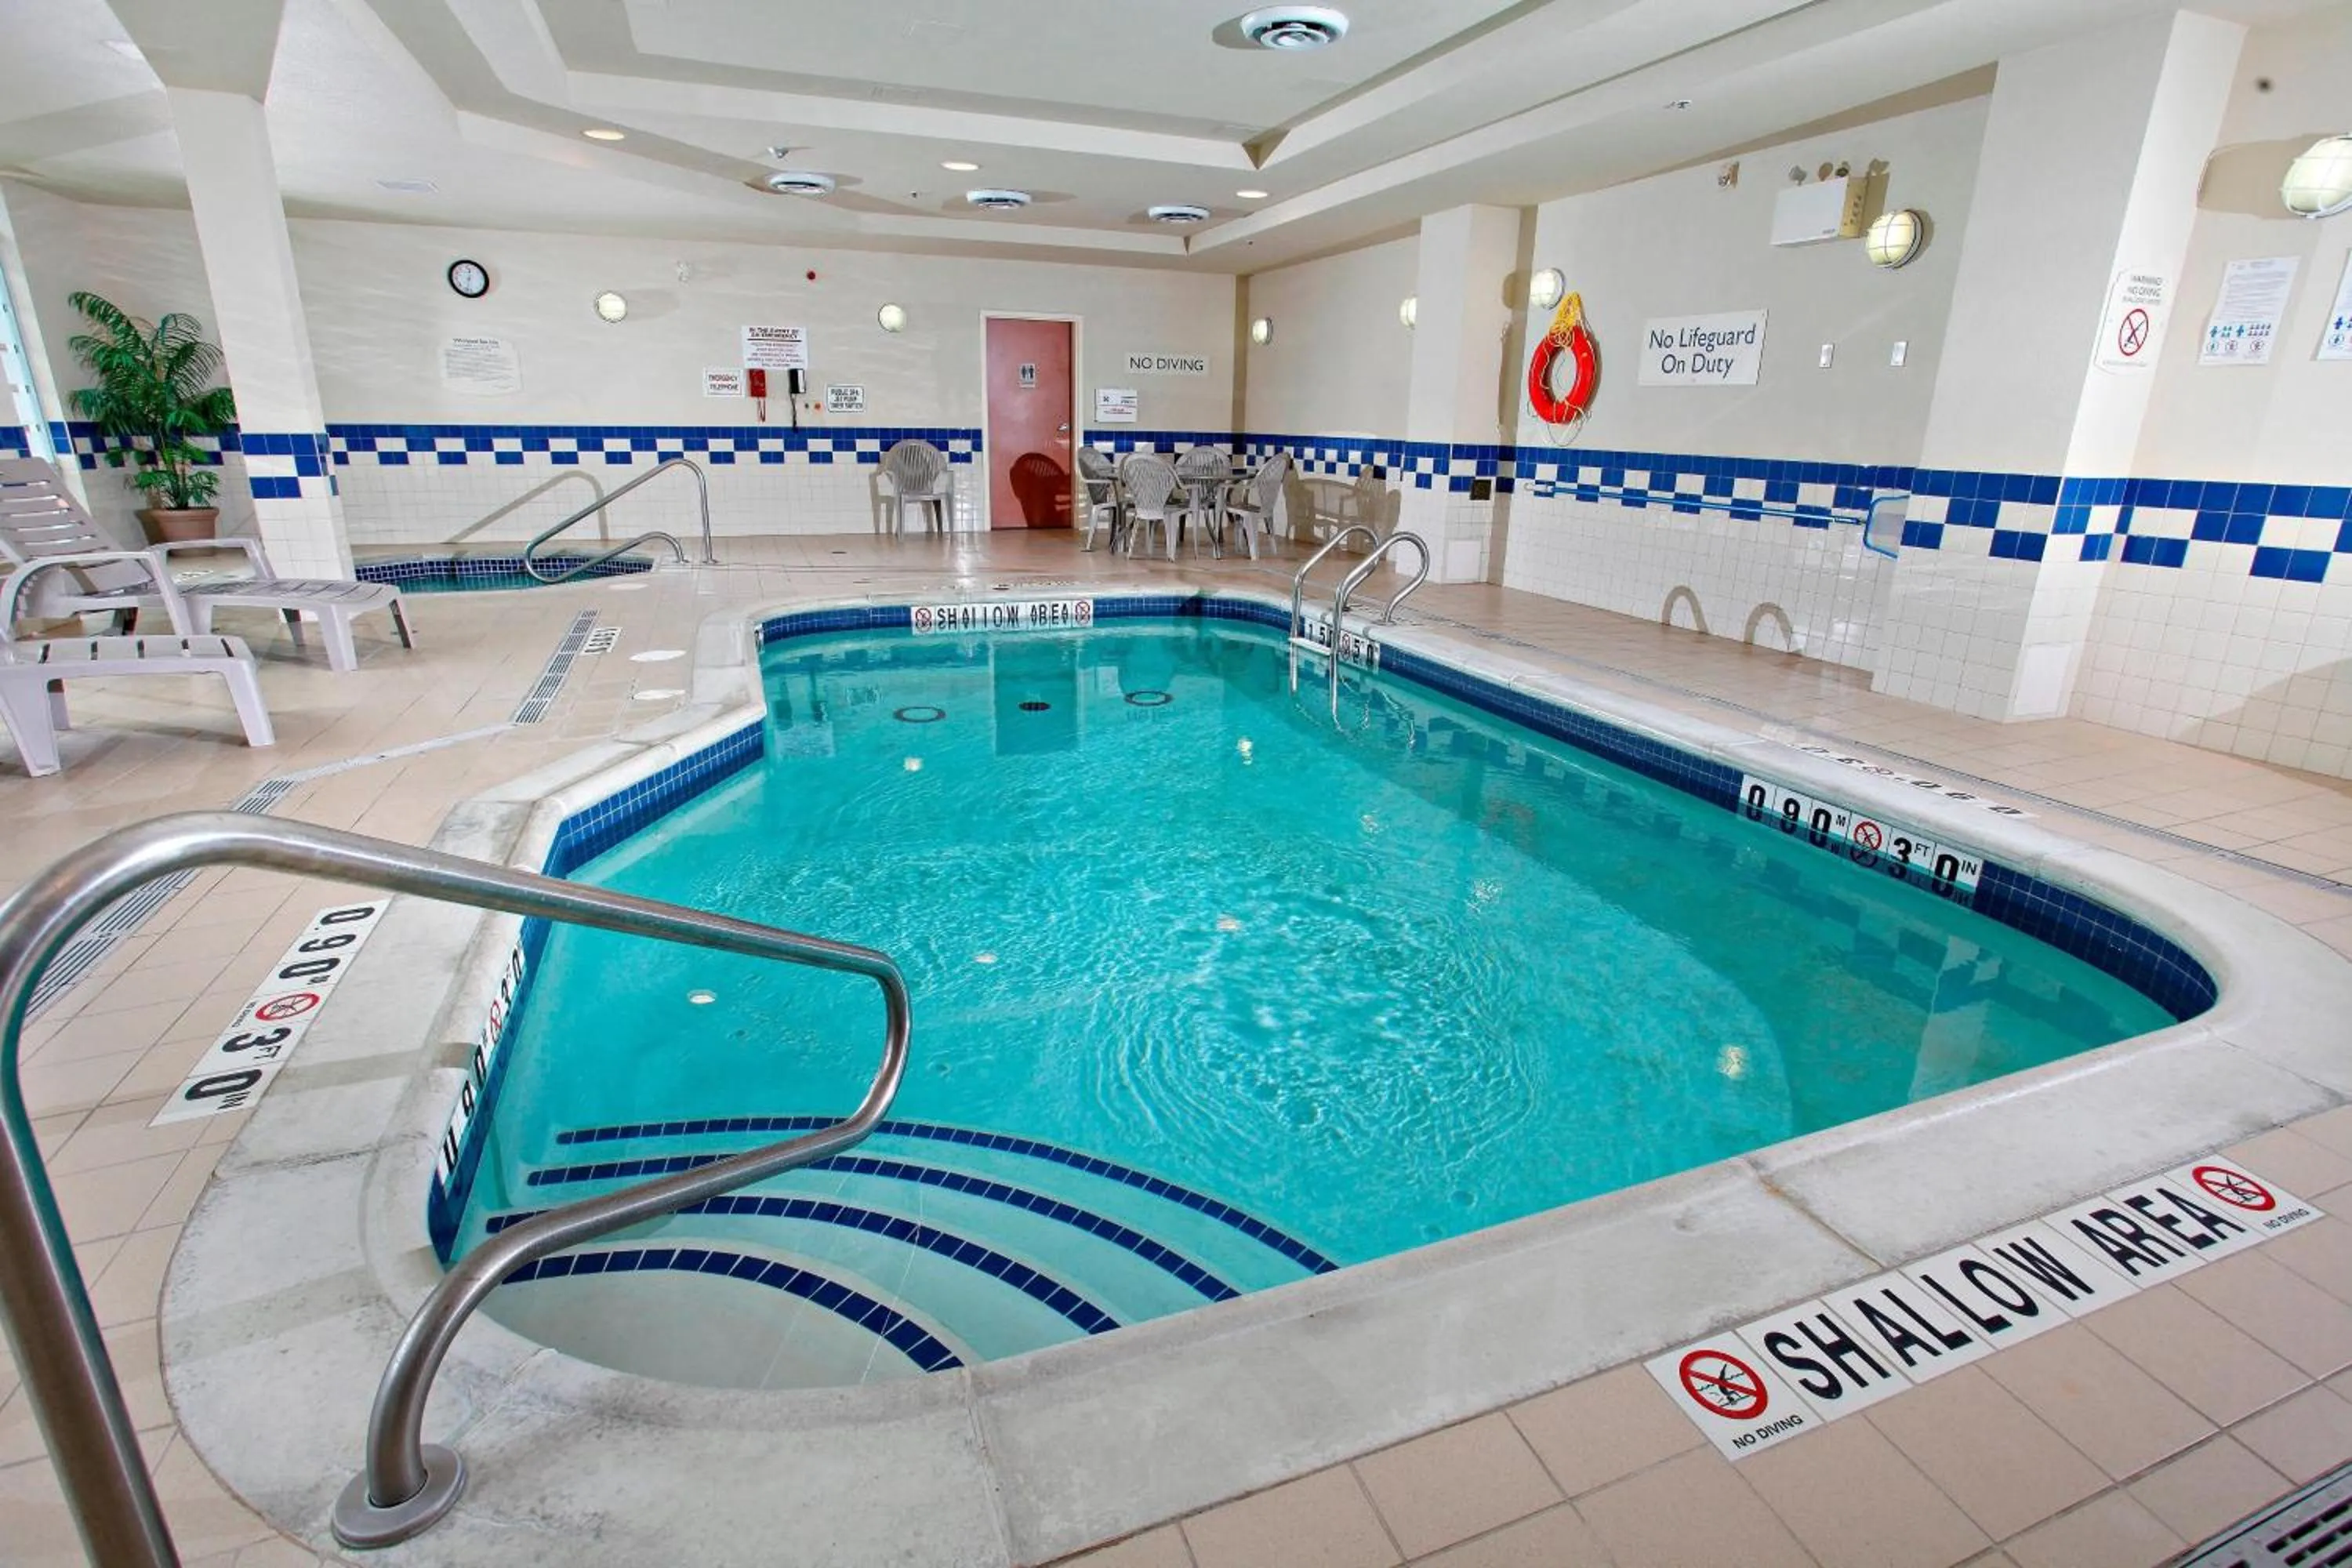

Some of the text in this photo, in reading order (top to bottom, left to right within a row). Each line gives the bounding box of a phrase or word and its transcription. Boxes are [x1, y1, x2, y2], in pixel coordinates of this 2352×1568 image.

[1649, 322, 1756, 352] No Lifeguard
[1130, 357, 1204, 371] NO DIVING
[1661, 353, 1733, 379] On Duty
[1030, 603, 1069, 624] AREA
[2263, 1208, 2310, 1229] NO DIVING
[1763, 1187, 2245, 1400] SHALLOW AREA
[1732, 1414, 1804, 1450] NO DIVING
